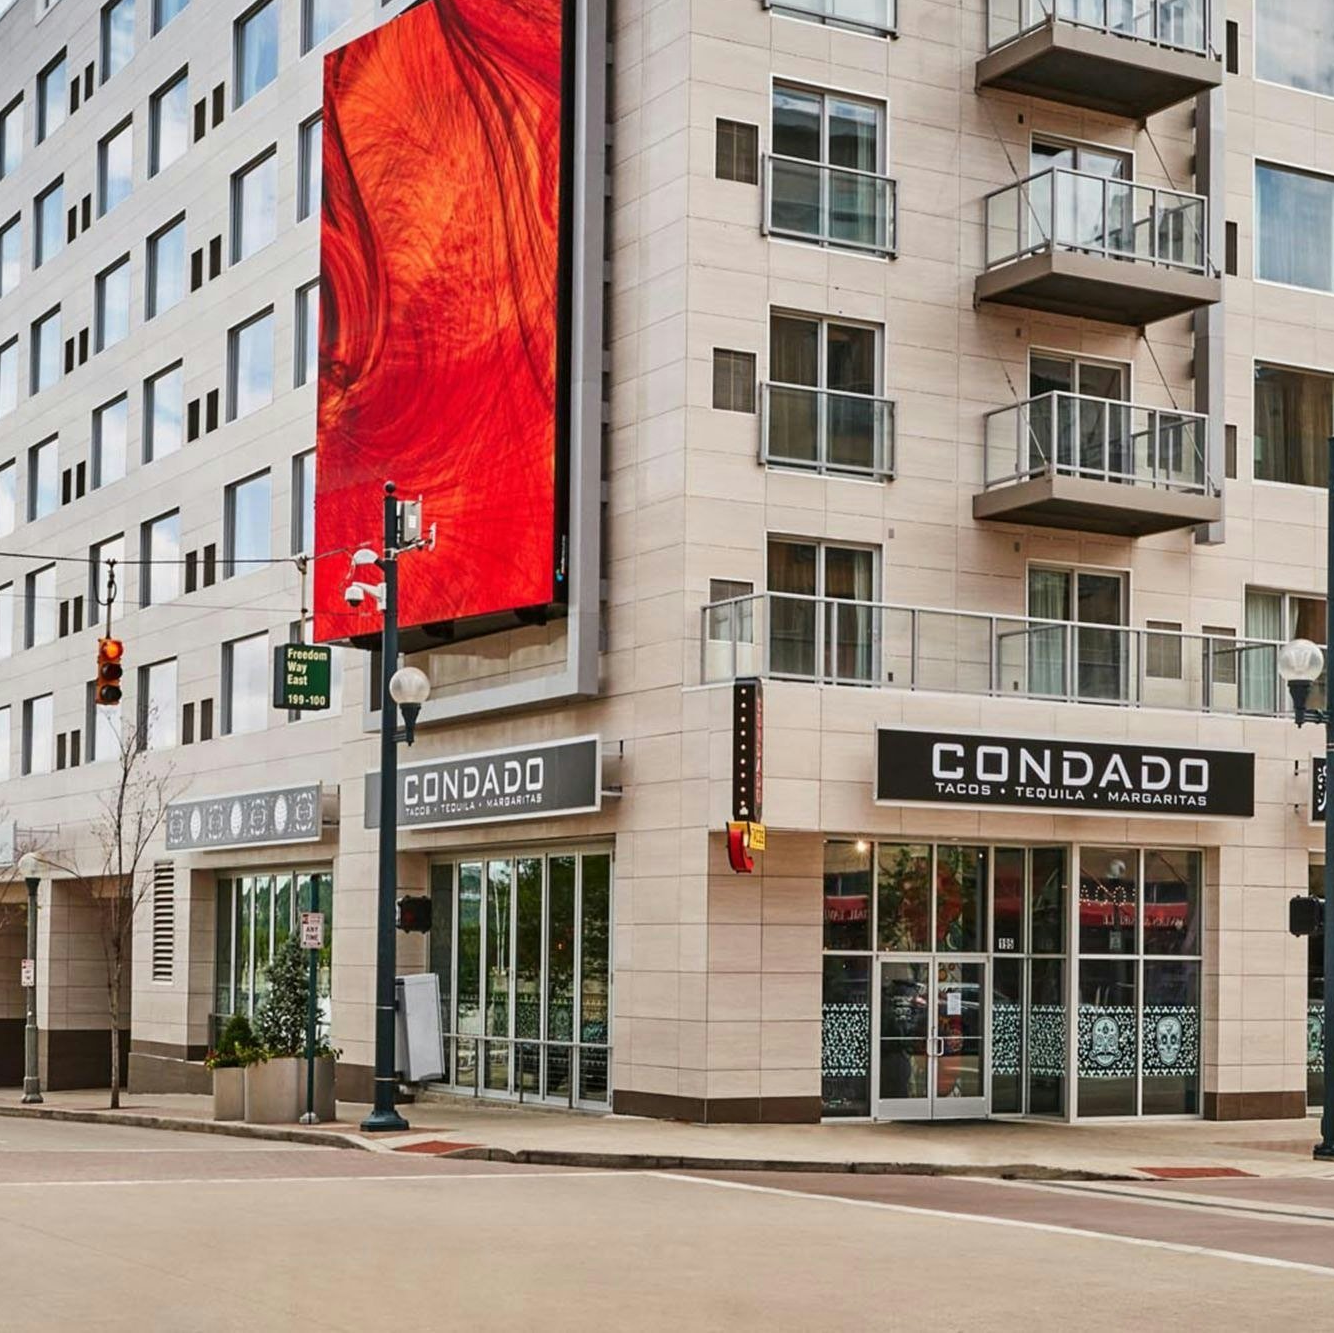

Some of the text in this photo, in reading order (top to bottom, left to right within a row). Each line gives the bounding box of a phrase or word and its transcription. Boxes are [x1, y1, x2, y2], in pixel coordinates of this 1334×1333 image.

[287, 648, 328, 661] Freedom
[287, 661, 307, 675] Way
[287, 674, 307, 686] East
[288, 694, 326, 706] 199-100
[931, 741, 1210, 793] CONDADO
[403, 756, 544, 806] CONDADO
[934, 782, 1208, 807] TACOS TEQUILA MARGARITAS
[405, 793, 543, 817] TACOS TEQUILA MARGARITAS
